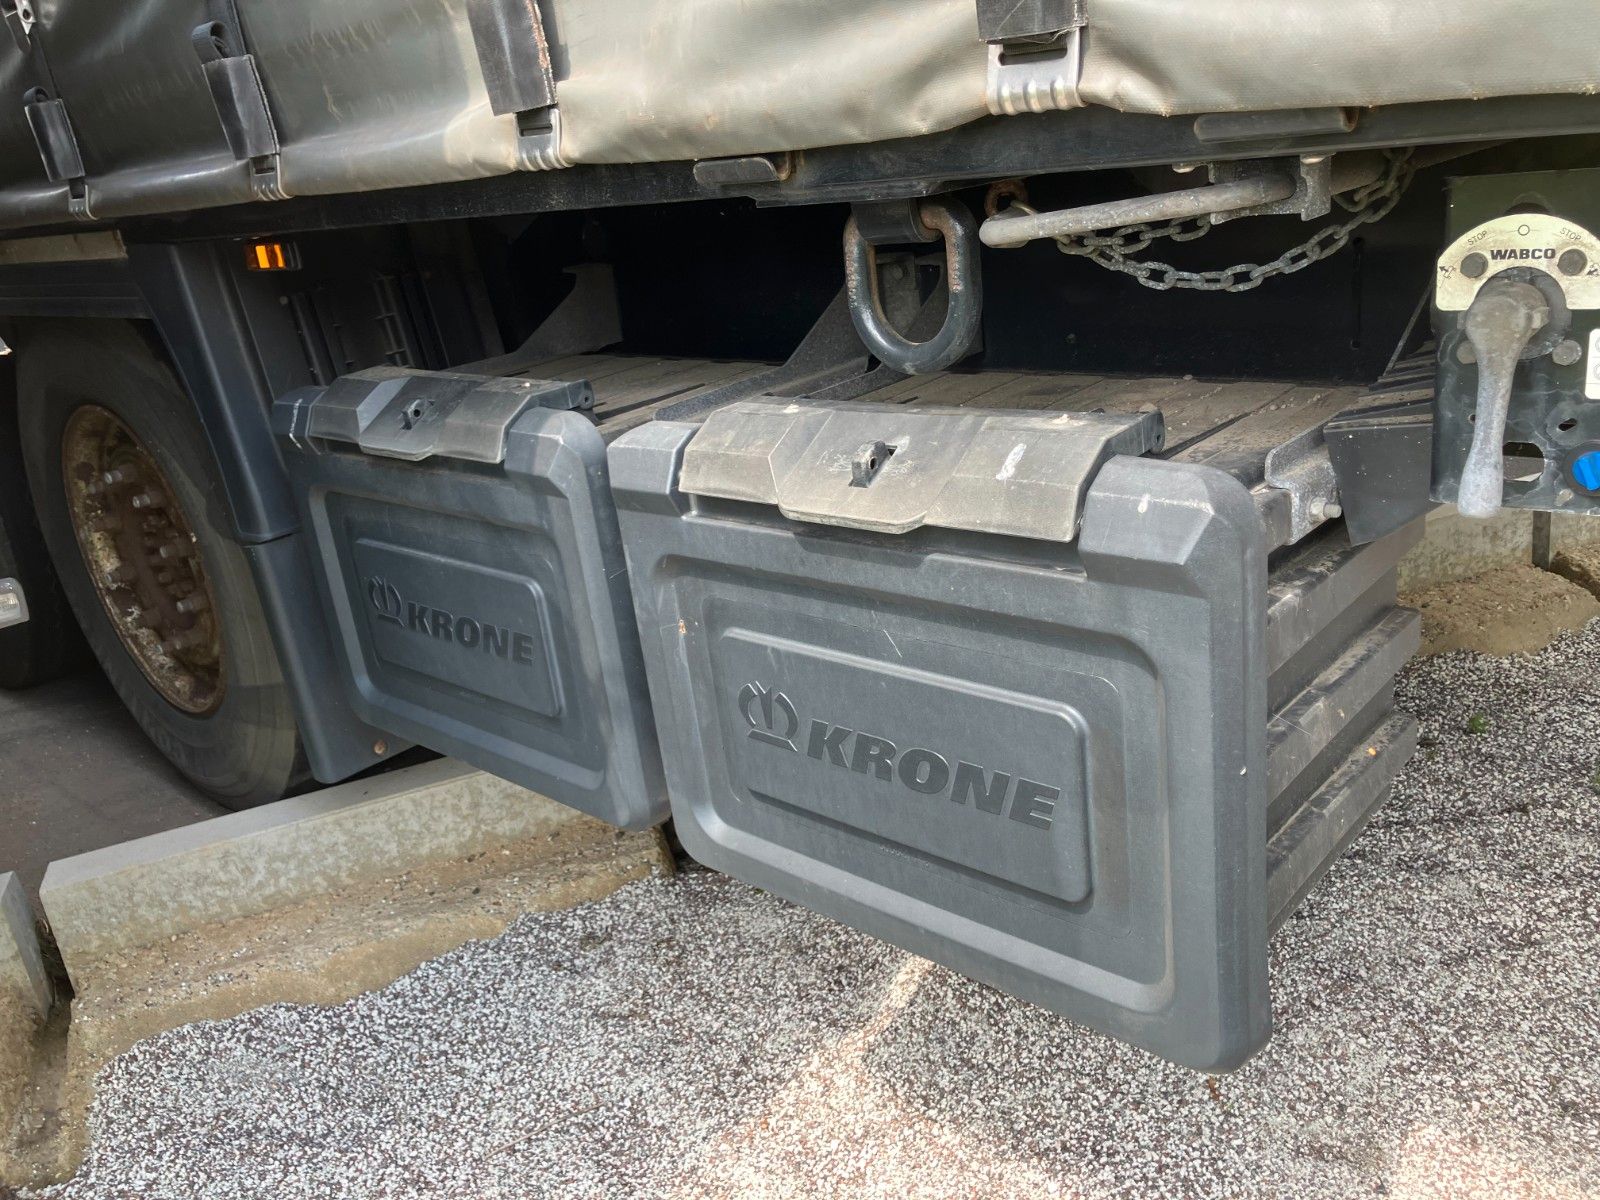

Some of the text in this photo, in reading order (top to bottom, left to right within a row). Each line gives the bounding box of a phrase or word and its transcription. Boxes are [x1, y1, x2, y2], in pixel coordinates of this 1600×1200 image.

[1467, 230, 1488, 246] STOP
[1559, 227, 1582, 241] STOP
[1490, 248, 1556, 260] WABCO
[407, 600, 534, 665] KRONE
[807, 718, 1061, 831] KRONE
